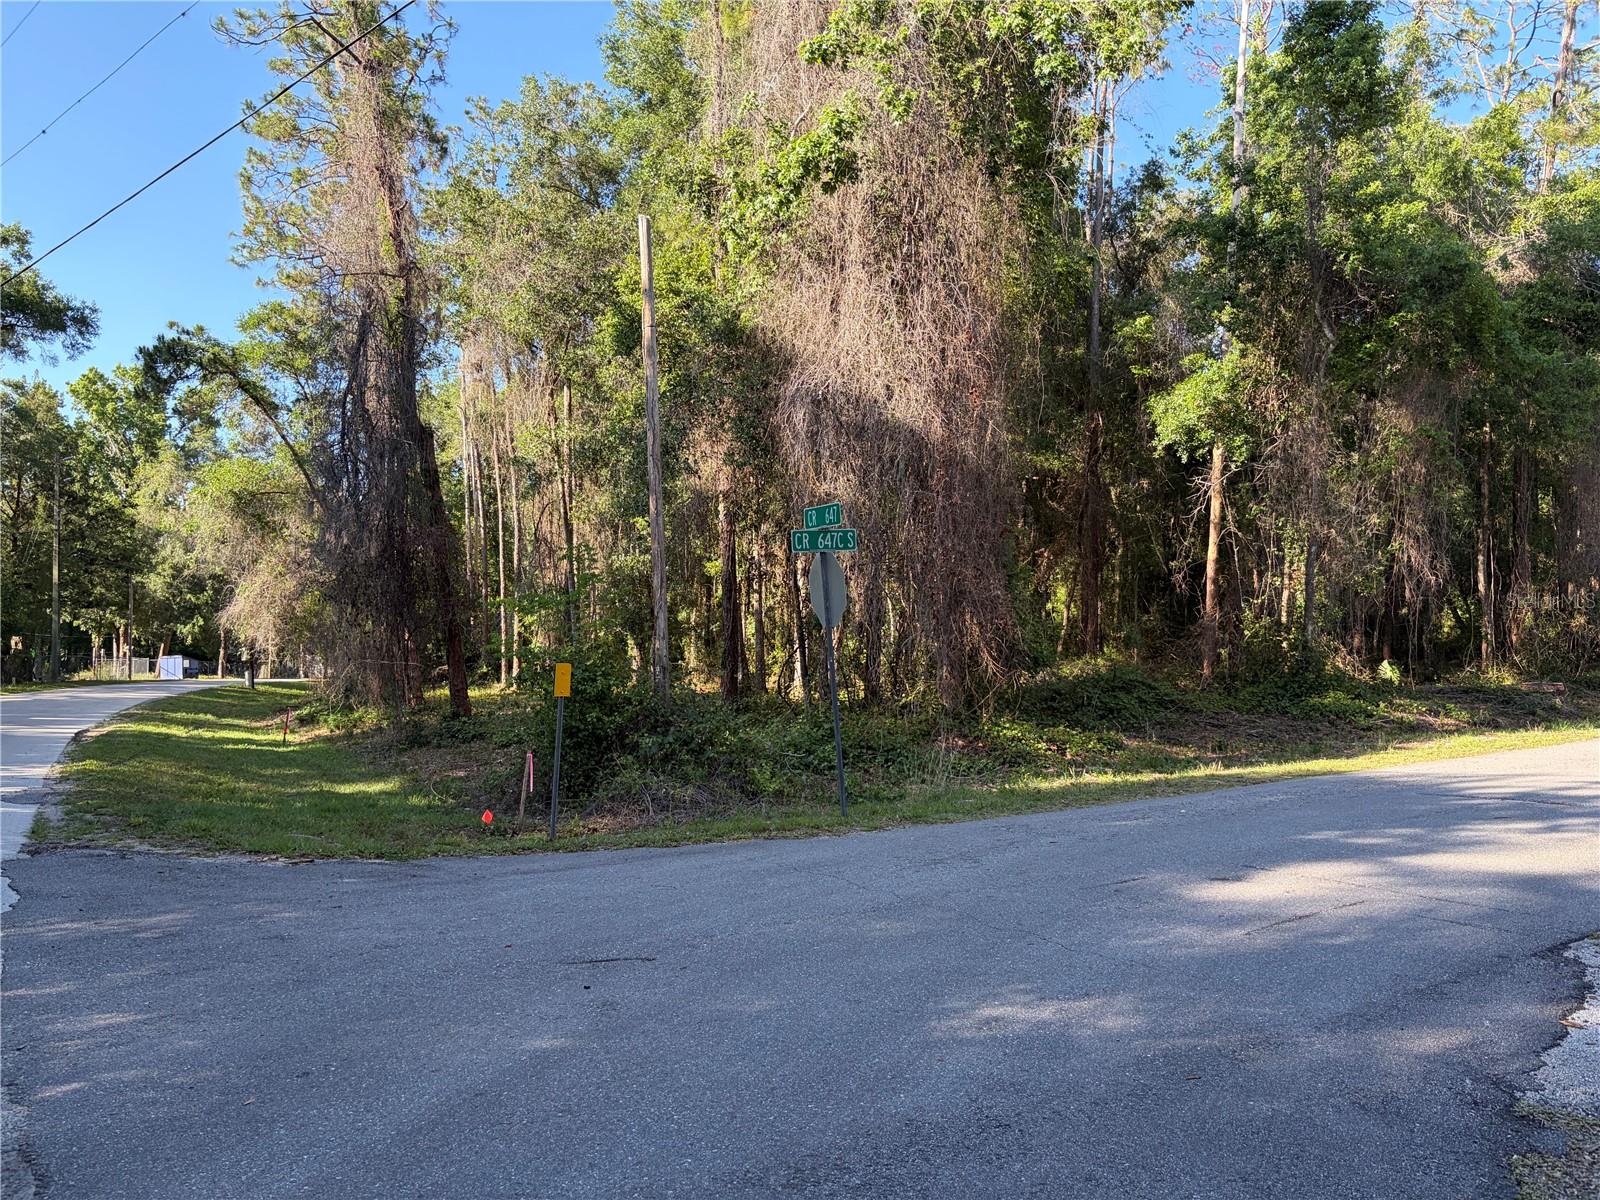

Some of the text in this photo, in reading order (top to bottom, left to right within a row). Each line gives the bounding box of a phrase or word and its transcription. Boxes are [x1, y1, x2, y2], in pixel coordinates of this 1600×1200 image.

[807, 506, 837, 527] CR 647
[795, 532, 854, 549] CR 647C S
